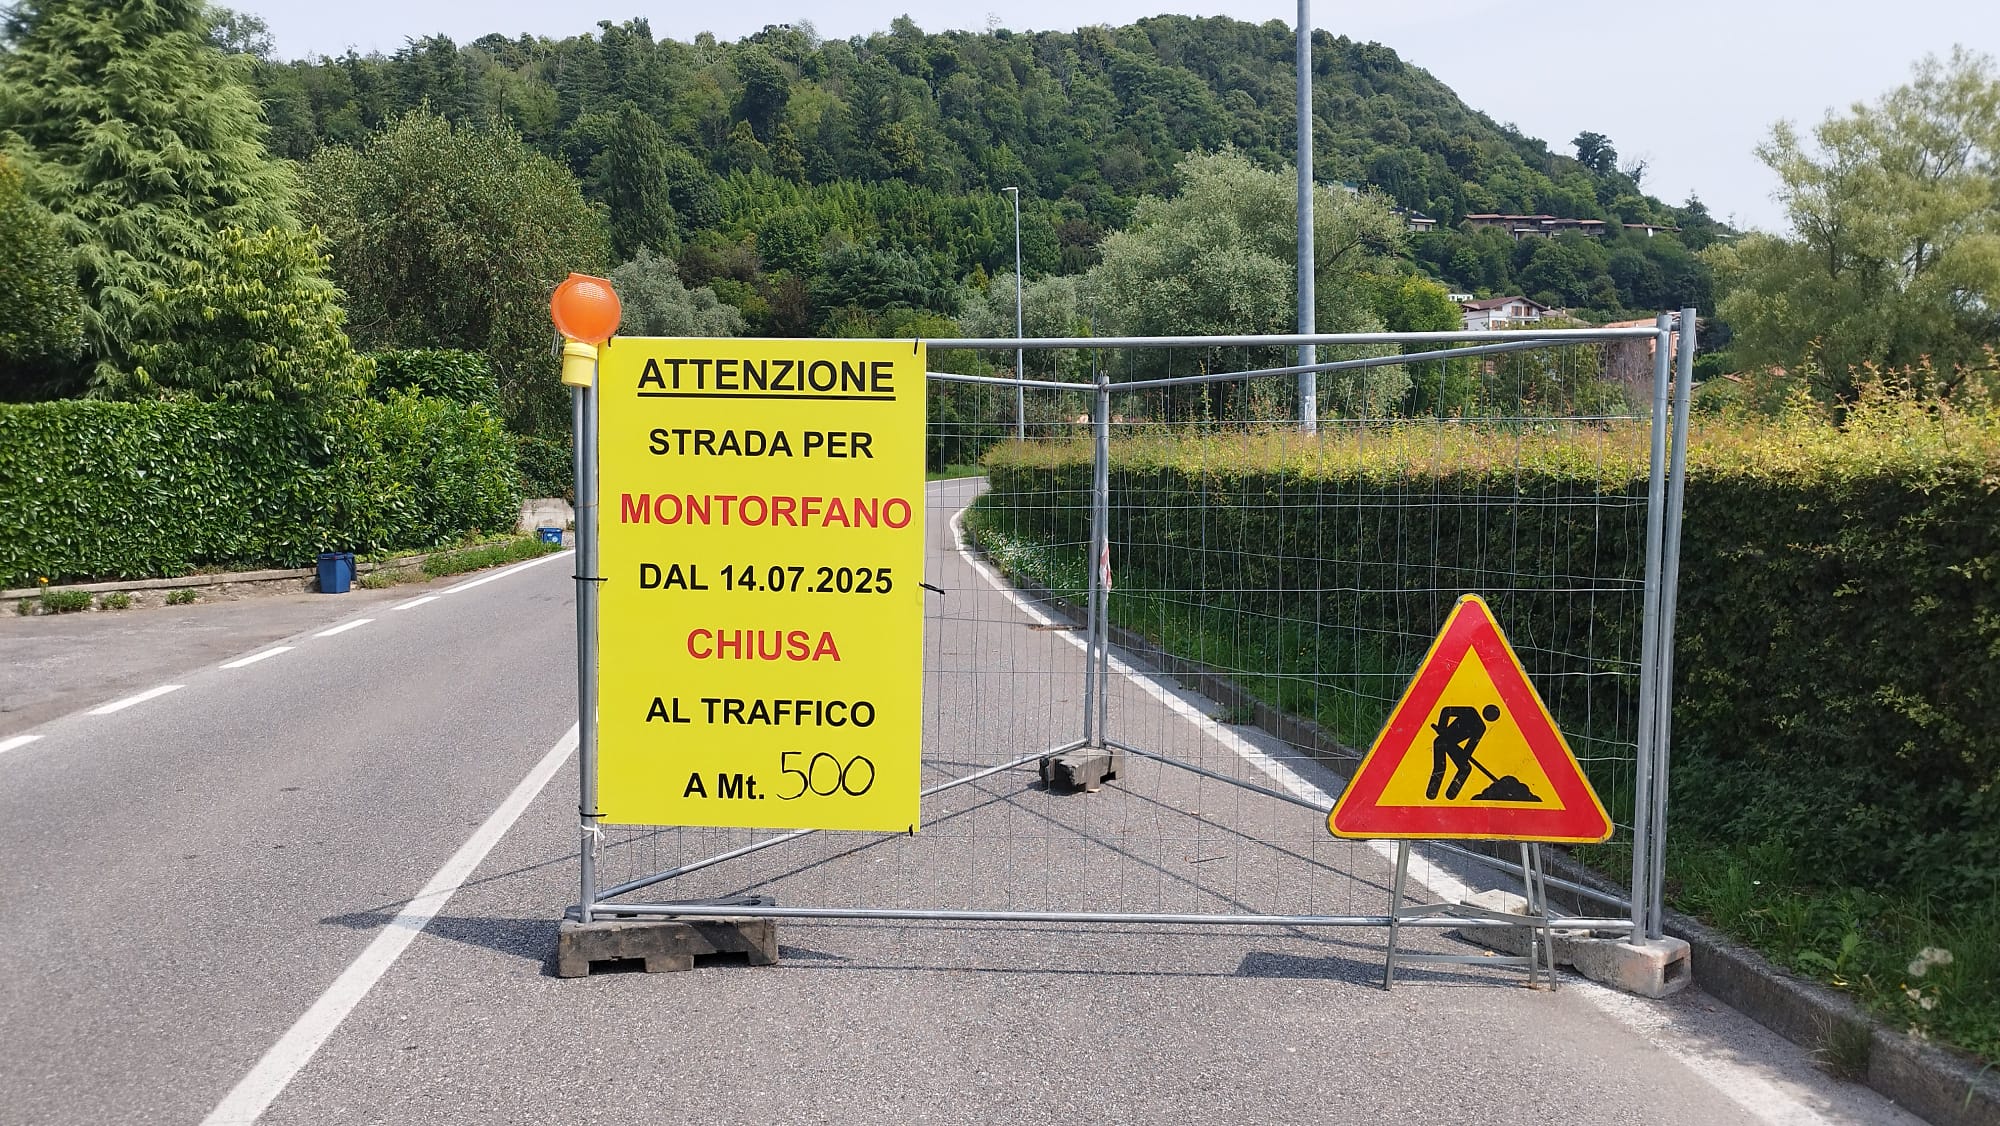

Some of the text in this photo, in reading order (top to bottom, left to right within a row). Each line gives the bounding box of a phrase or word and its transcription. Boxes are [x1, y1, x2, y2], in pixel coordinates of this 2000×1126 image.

[638, 359, 894, 392] ATTENZIONE
[649, 429, 873, 458] STRADA PER
[622, 494, 911, 528] MONTORFANO
[640, 563, 892, 594] DAL 14.07.2025
[688, 629, 840, 661] CHIUSA
[646, 697, 875, 727] AL TRAFFICO
[683, 752, 875, 800] A Mt. 500
